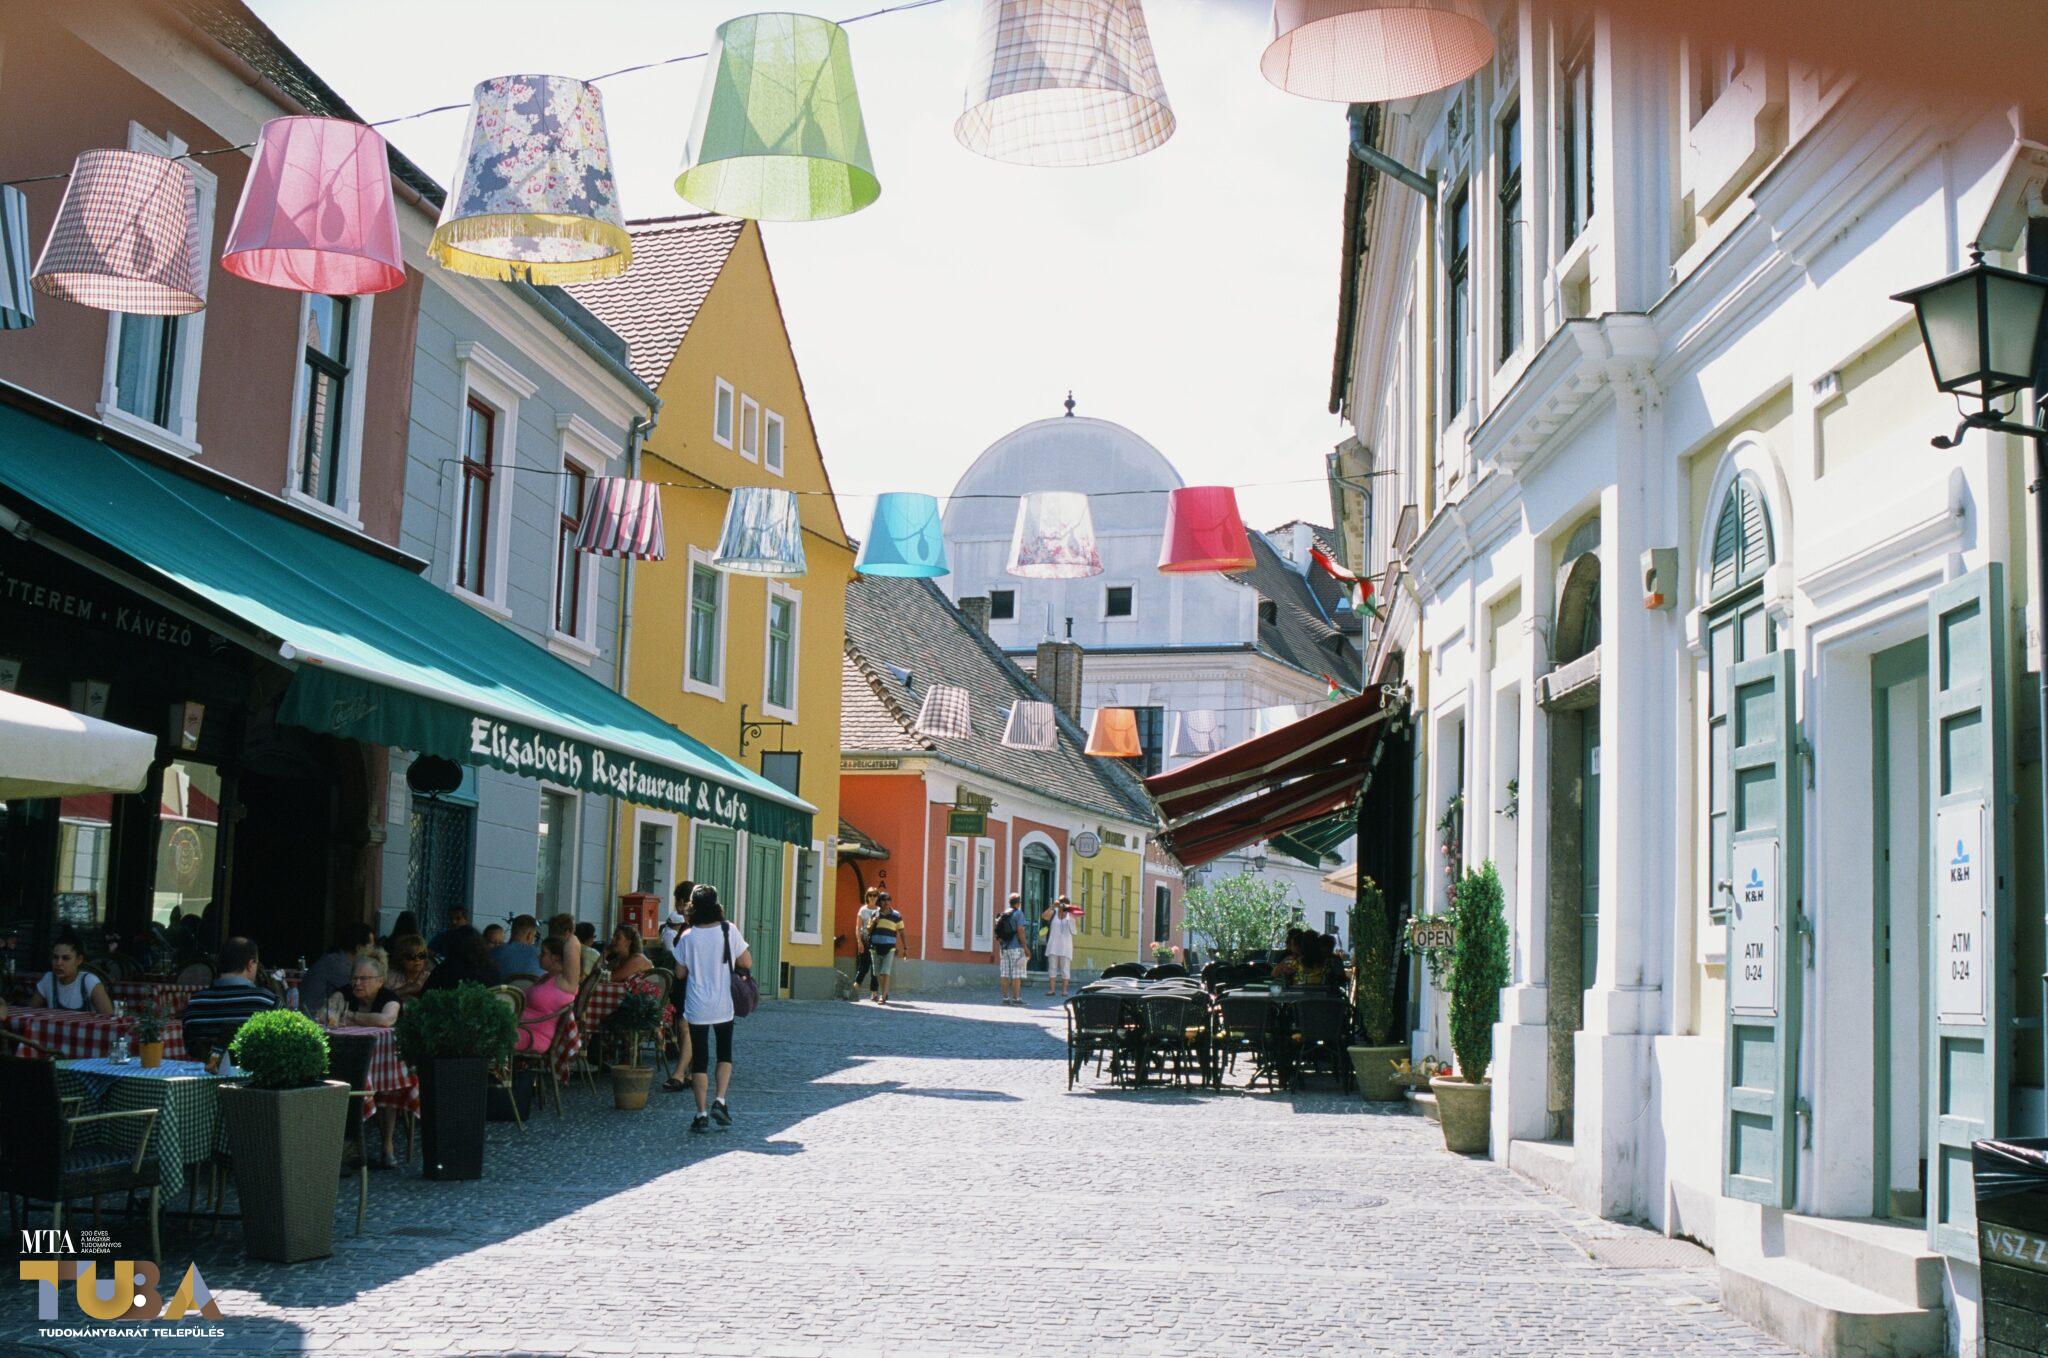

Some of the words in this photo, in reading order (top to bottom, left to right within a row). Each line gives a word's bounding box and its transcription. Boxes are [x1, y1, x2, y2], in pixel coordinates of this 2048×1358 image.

[0, 564, 94, 620] TTEREM
[116, 606, 193, 647] KÁVÉZÓ
[470, 716, 583, 786] Elisabeth
[591, 749, 692, 806] Restaurant
[696, 781, 711, 812] &
[715, 786, 748, 825] Cafe
[1950, 866, 1970, 882] K&H
[1745, 890, 1764, 902] K&H
[1417, 930, 1454, 947] OPEN
[1951, 932, 1971, 953] ATM
[1745, 943, 1764, 959] ATM
[1745, 964, 1763, 981] 0-24
[1951, 960, 1970, 981] 0-24
[1987, 1229, 2029, 1260] VSZ
